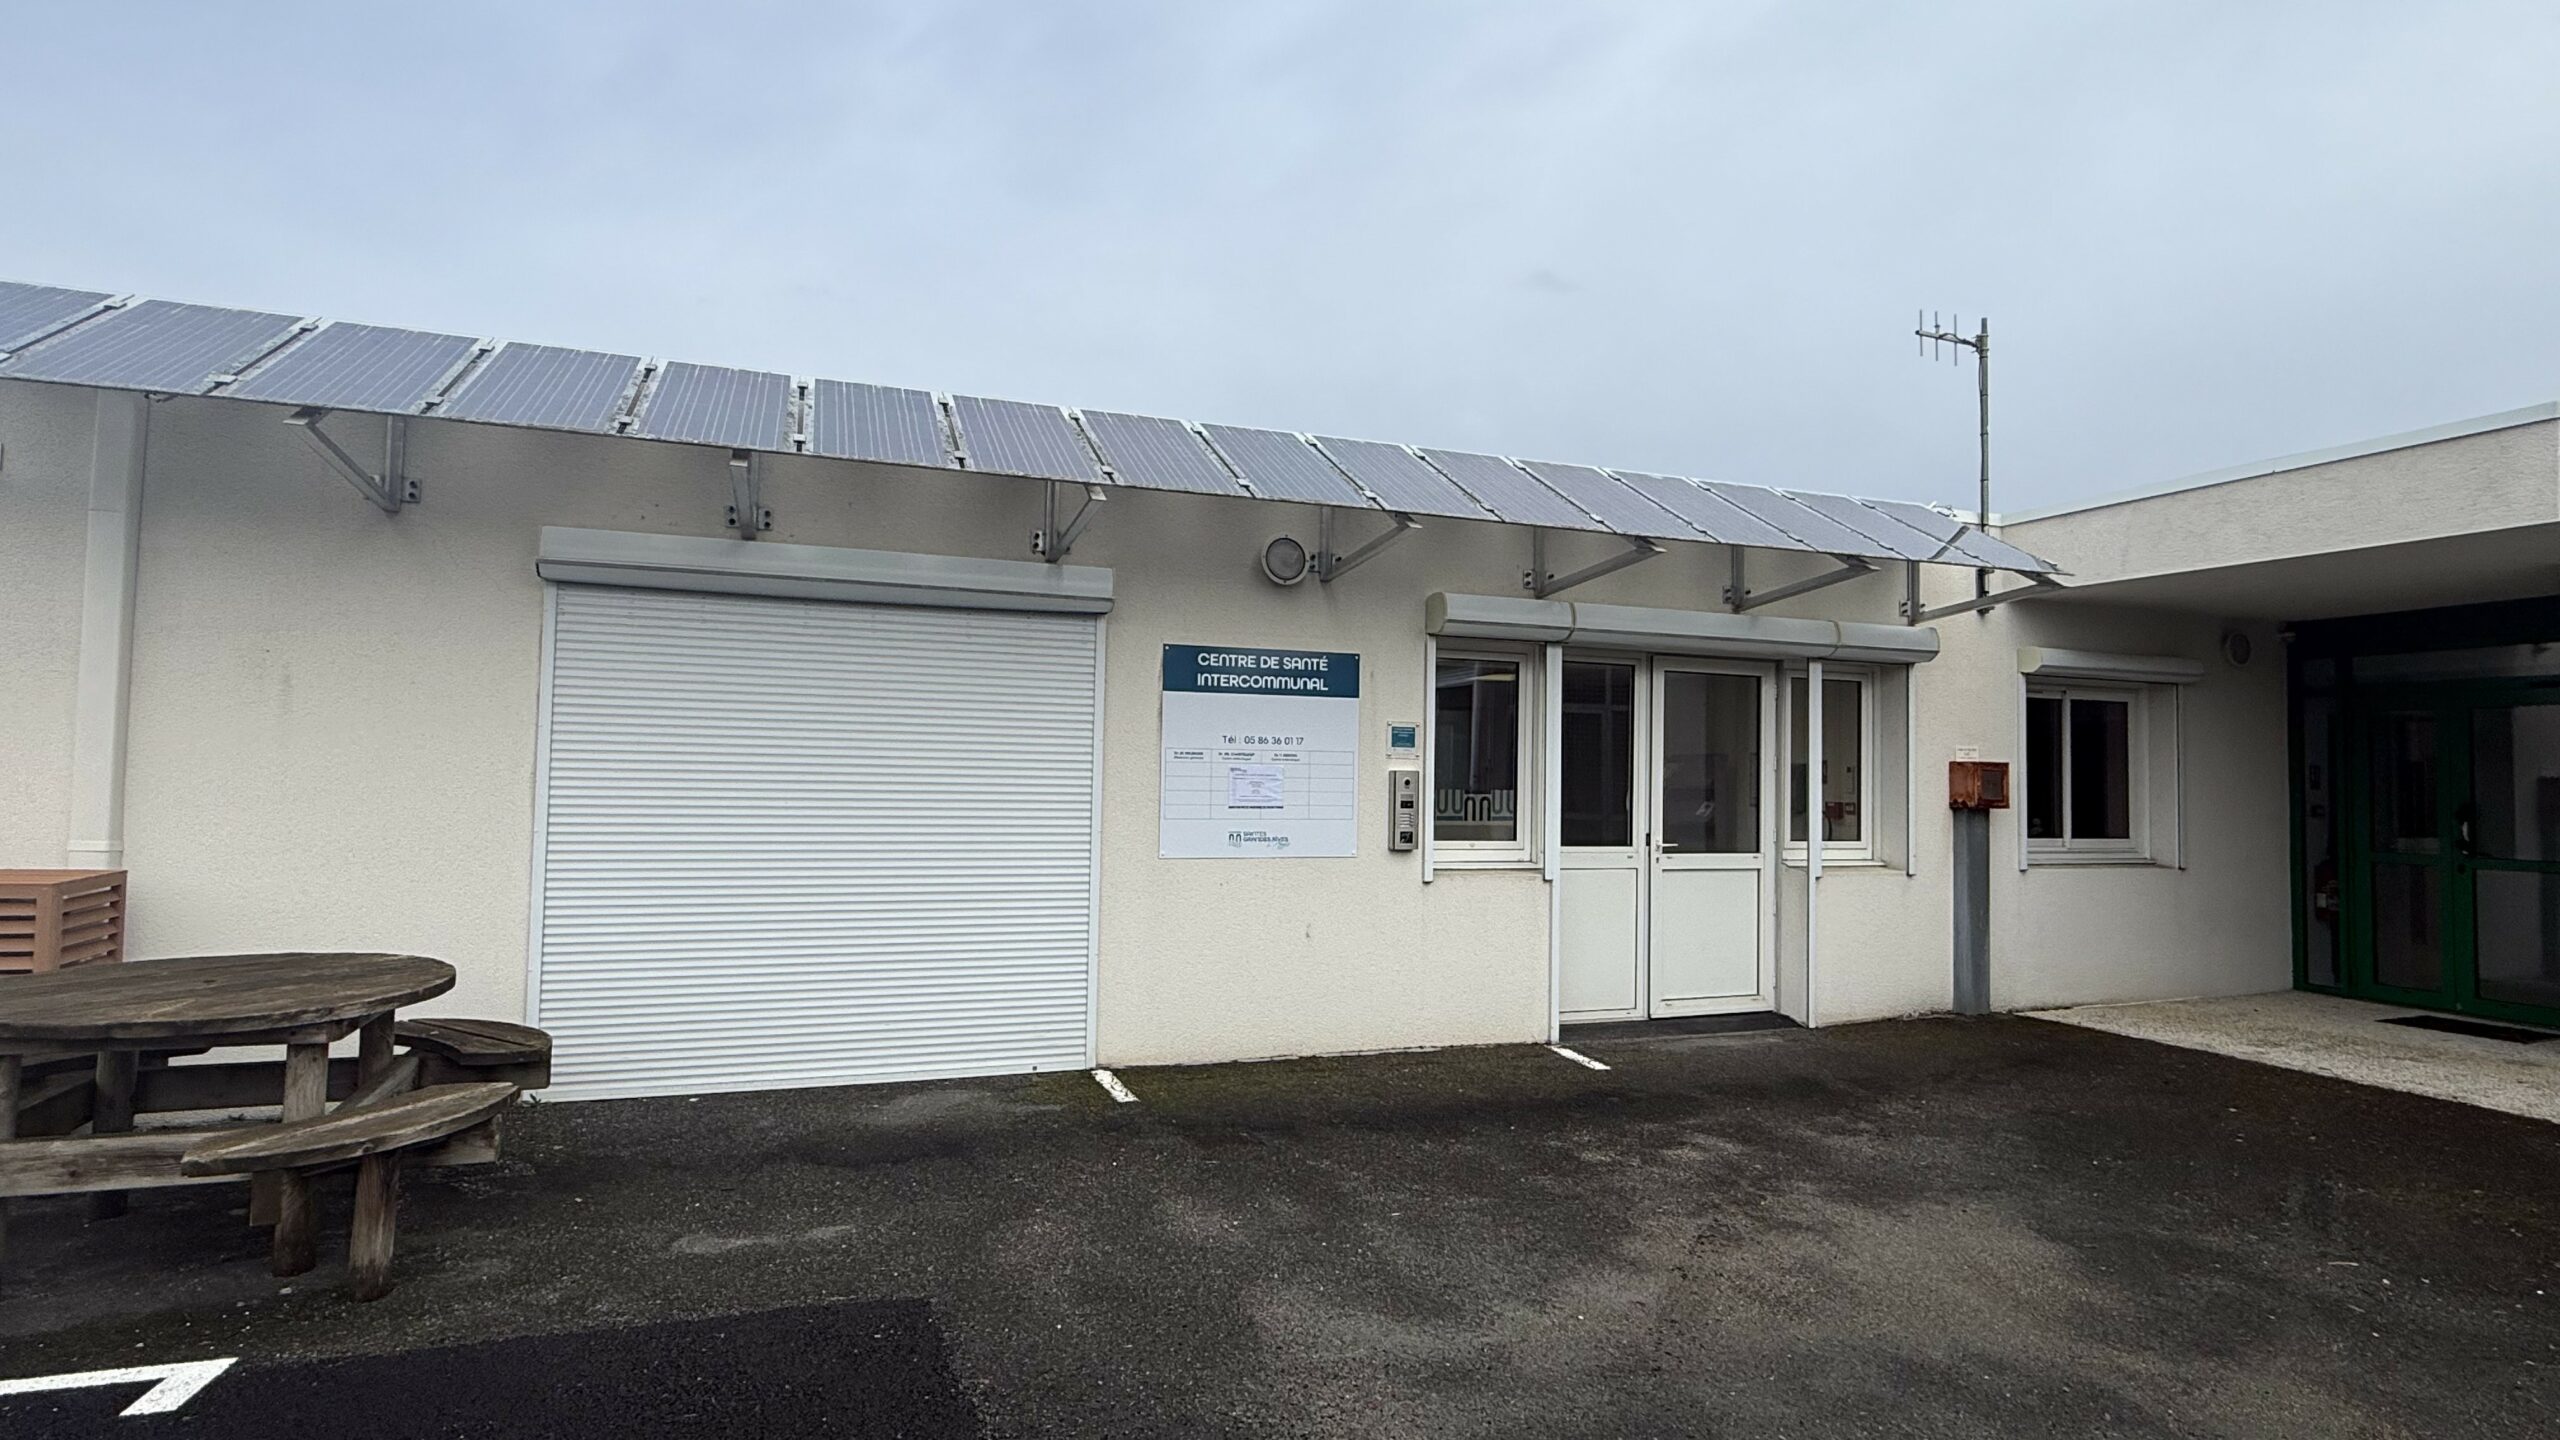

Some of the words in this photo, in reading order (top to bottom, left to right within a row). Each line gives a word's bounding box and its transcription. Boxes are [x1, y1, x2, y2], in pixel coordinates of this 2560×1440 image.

[1197, 653, 1257, 668] CENTRE
[1260, 656, 1280, 669] DE
[1282, 656, 1329, 671] SANTÉ
[1197, 673, 1329, 691] INTERCOMMUNAL
[1222, 735, 1237, 744] Tél
[1244, 735, 1256, 745] 05
[1257, 736, 1269, 745] 86
[1271, 736, 1282, 745] 36
[1284, 736, 1294, 746] 01
[1295, 737, 1304, 746] 17
